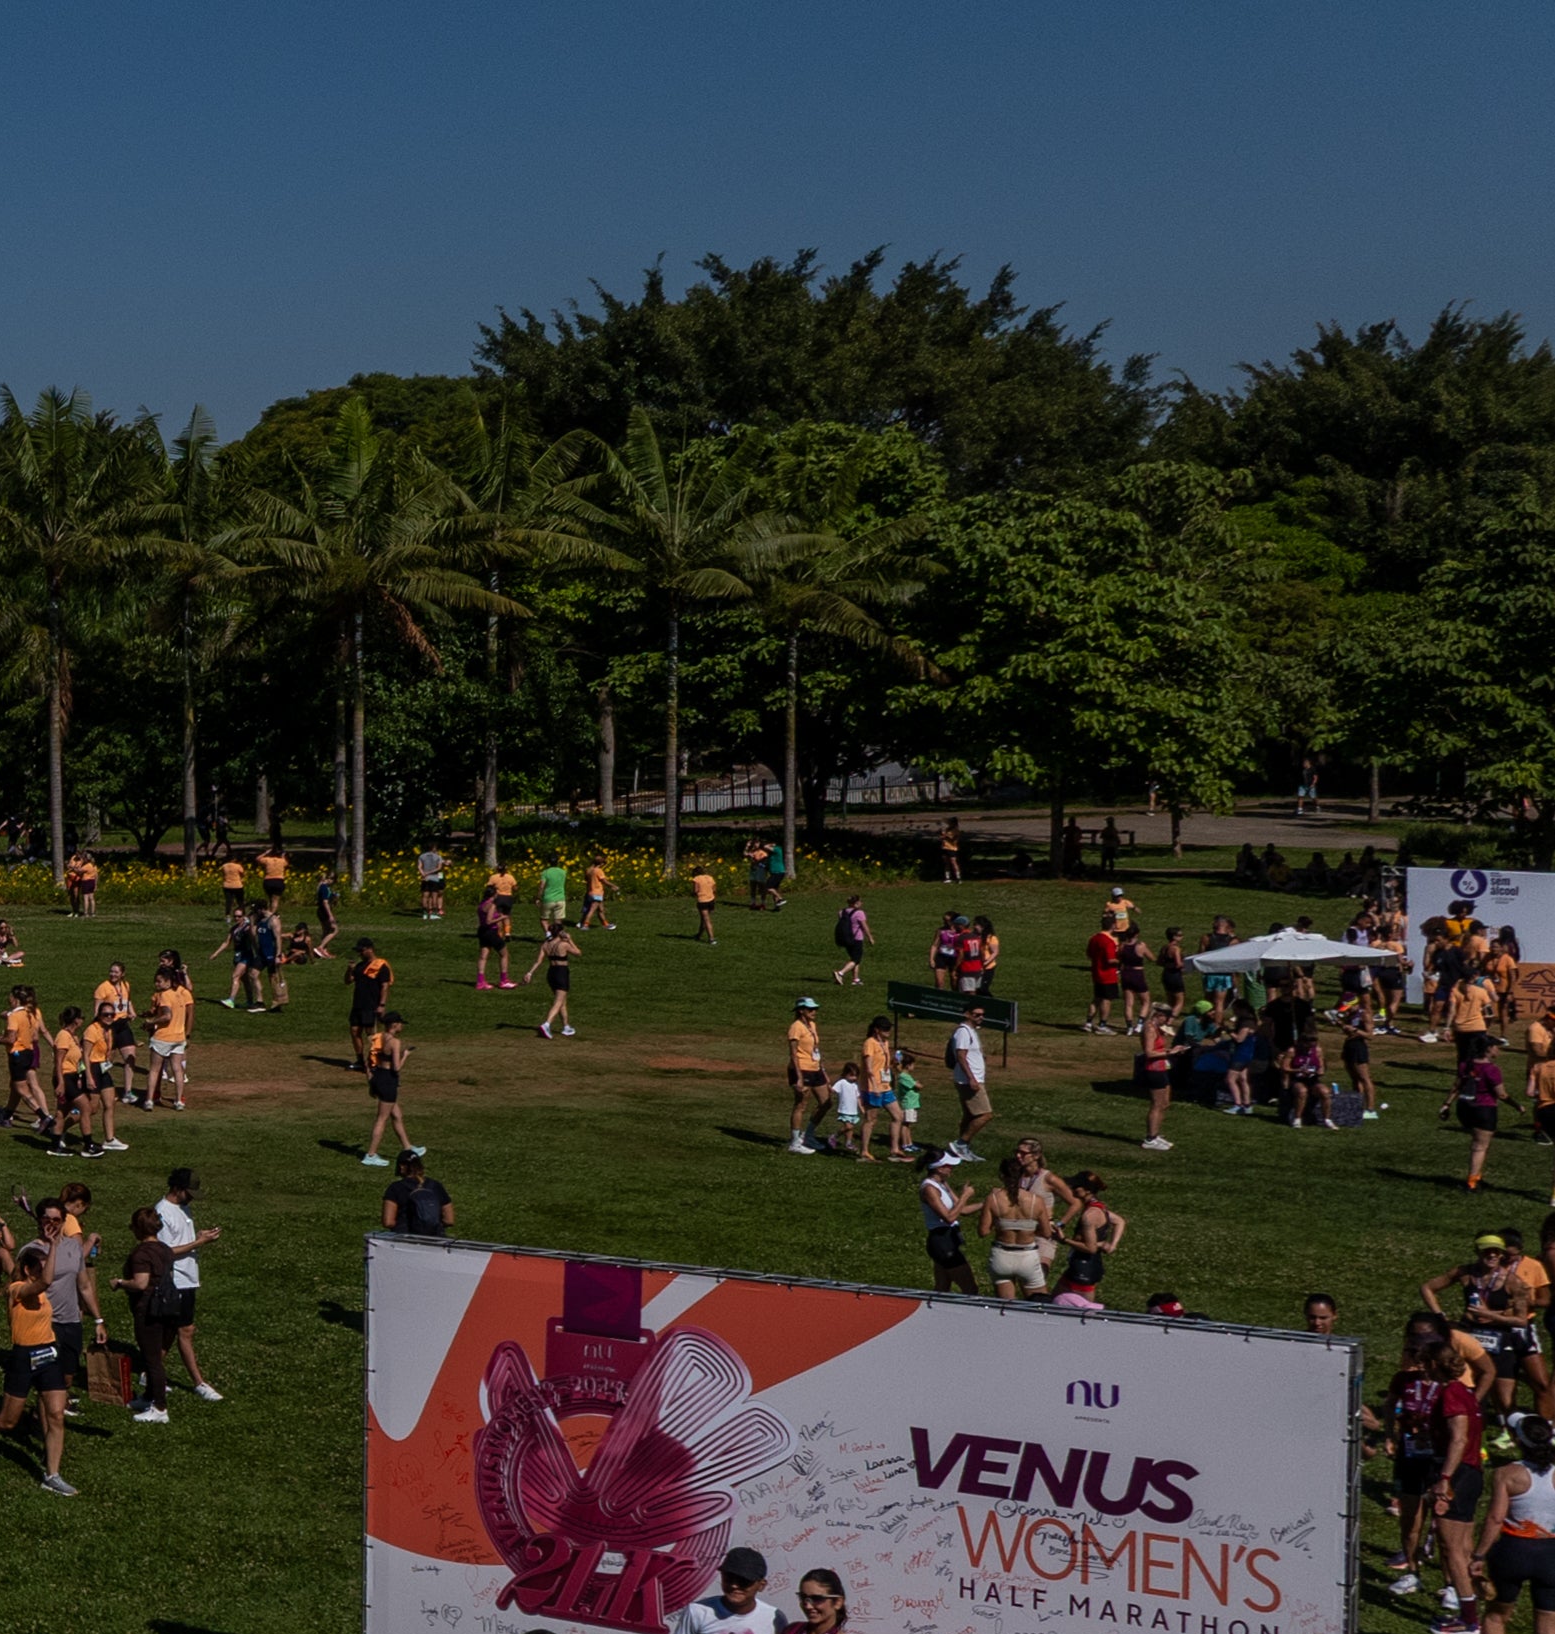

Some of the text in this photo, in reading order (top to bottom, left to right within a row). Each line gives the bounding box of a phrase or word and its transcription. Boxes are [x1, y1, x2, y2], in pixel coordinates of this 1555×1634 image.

[1066, 1379, 1119, 1409] nu
[909, 1426, 1199, 1523] VENUS
[956, 1505, 1282, 1613] WOMEN'S
[959, 1577, 1048, 1610] HALF
